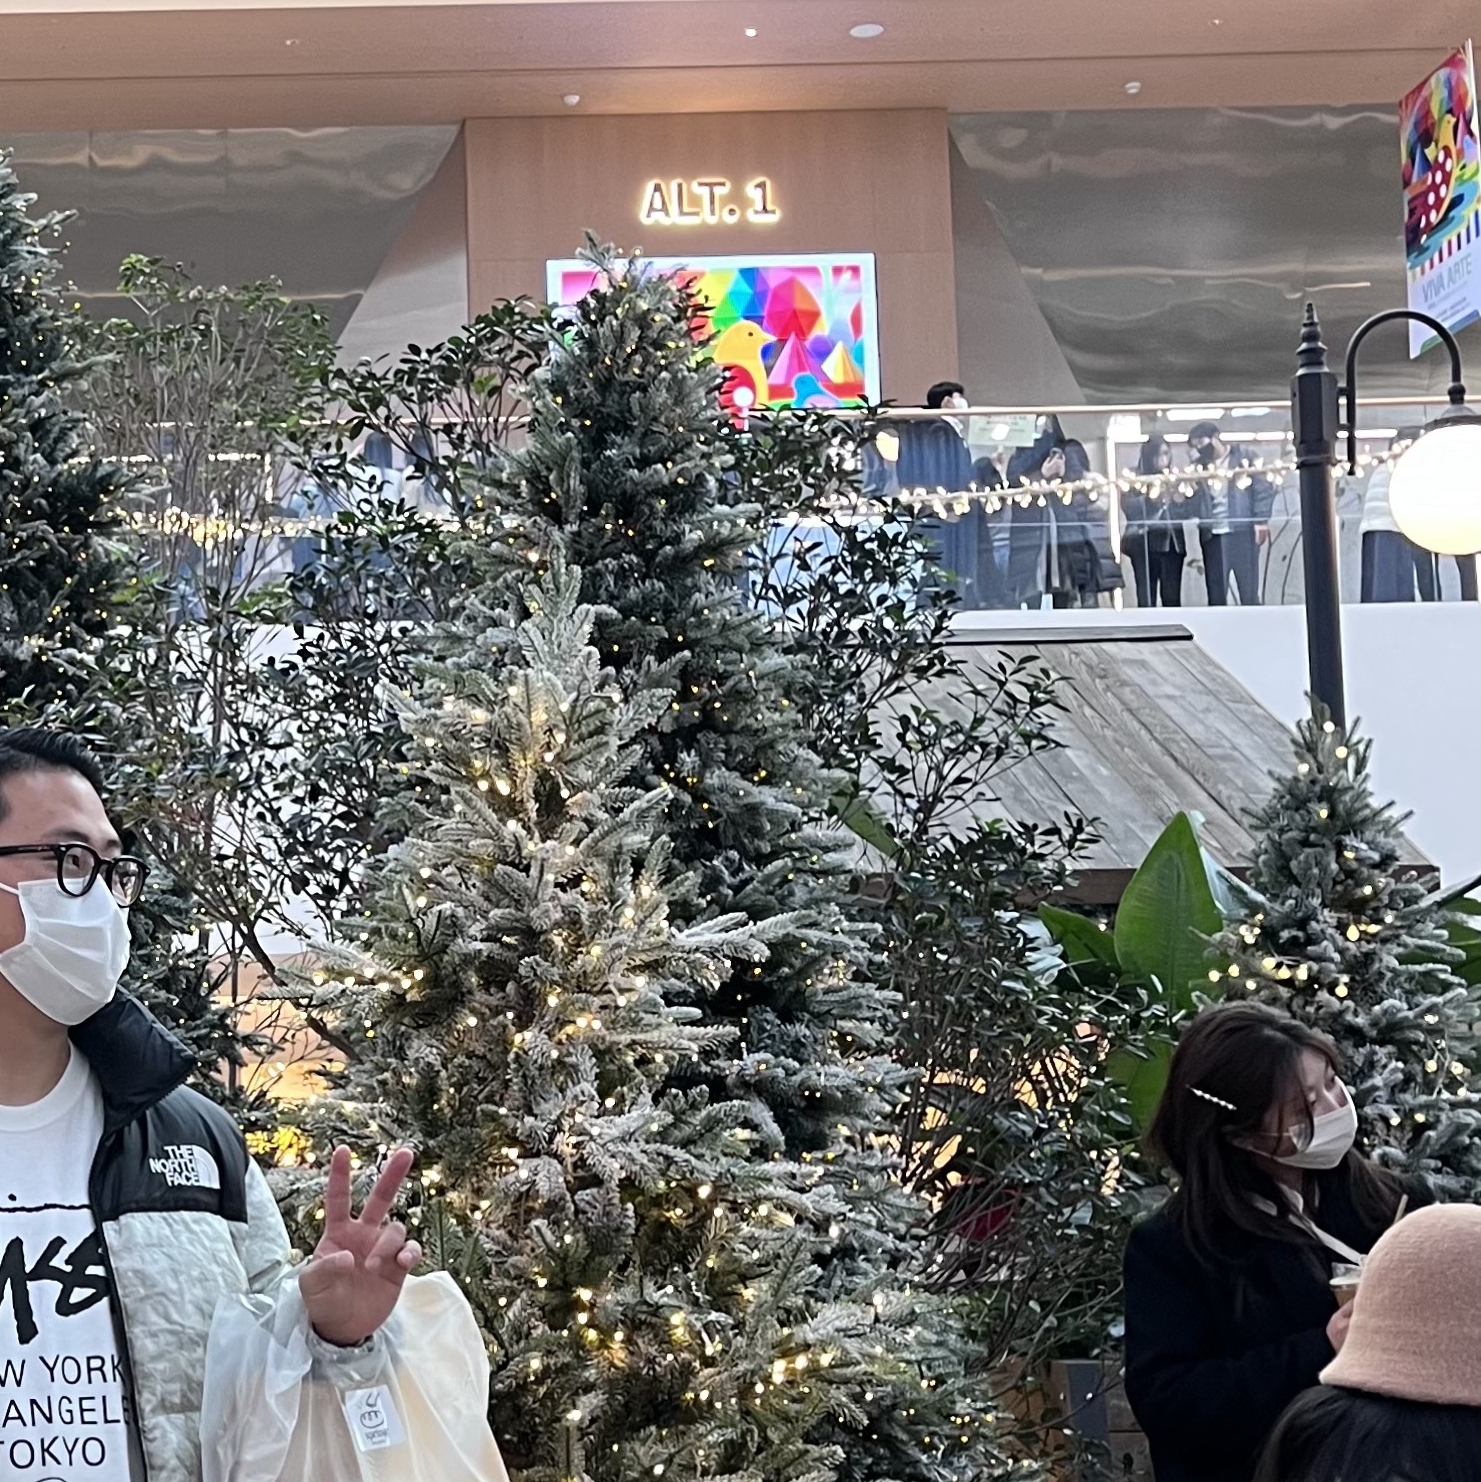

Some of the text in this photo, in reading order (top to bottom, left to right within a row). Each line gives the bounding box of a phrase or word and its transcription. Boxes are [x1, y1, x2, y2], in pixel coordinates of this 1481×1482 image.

[643, 178, 777, 221] ALT. 1
[163, 1144, 194, 1160] THE
[149, 1158, 197, 1173] NORTH
[165, 1172, 201, 1187] FACE
[38, 1354, 125, 1386] YORK
